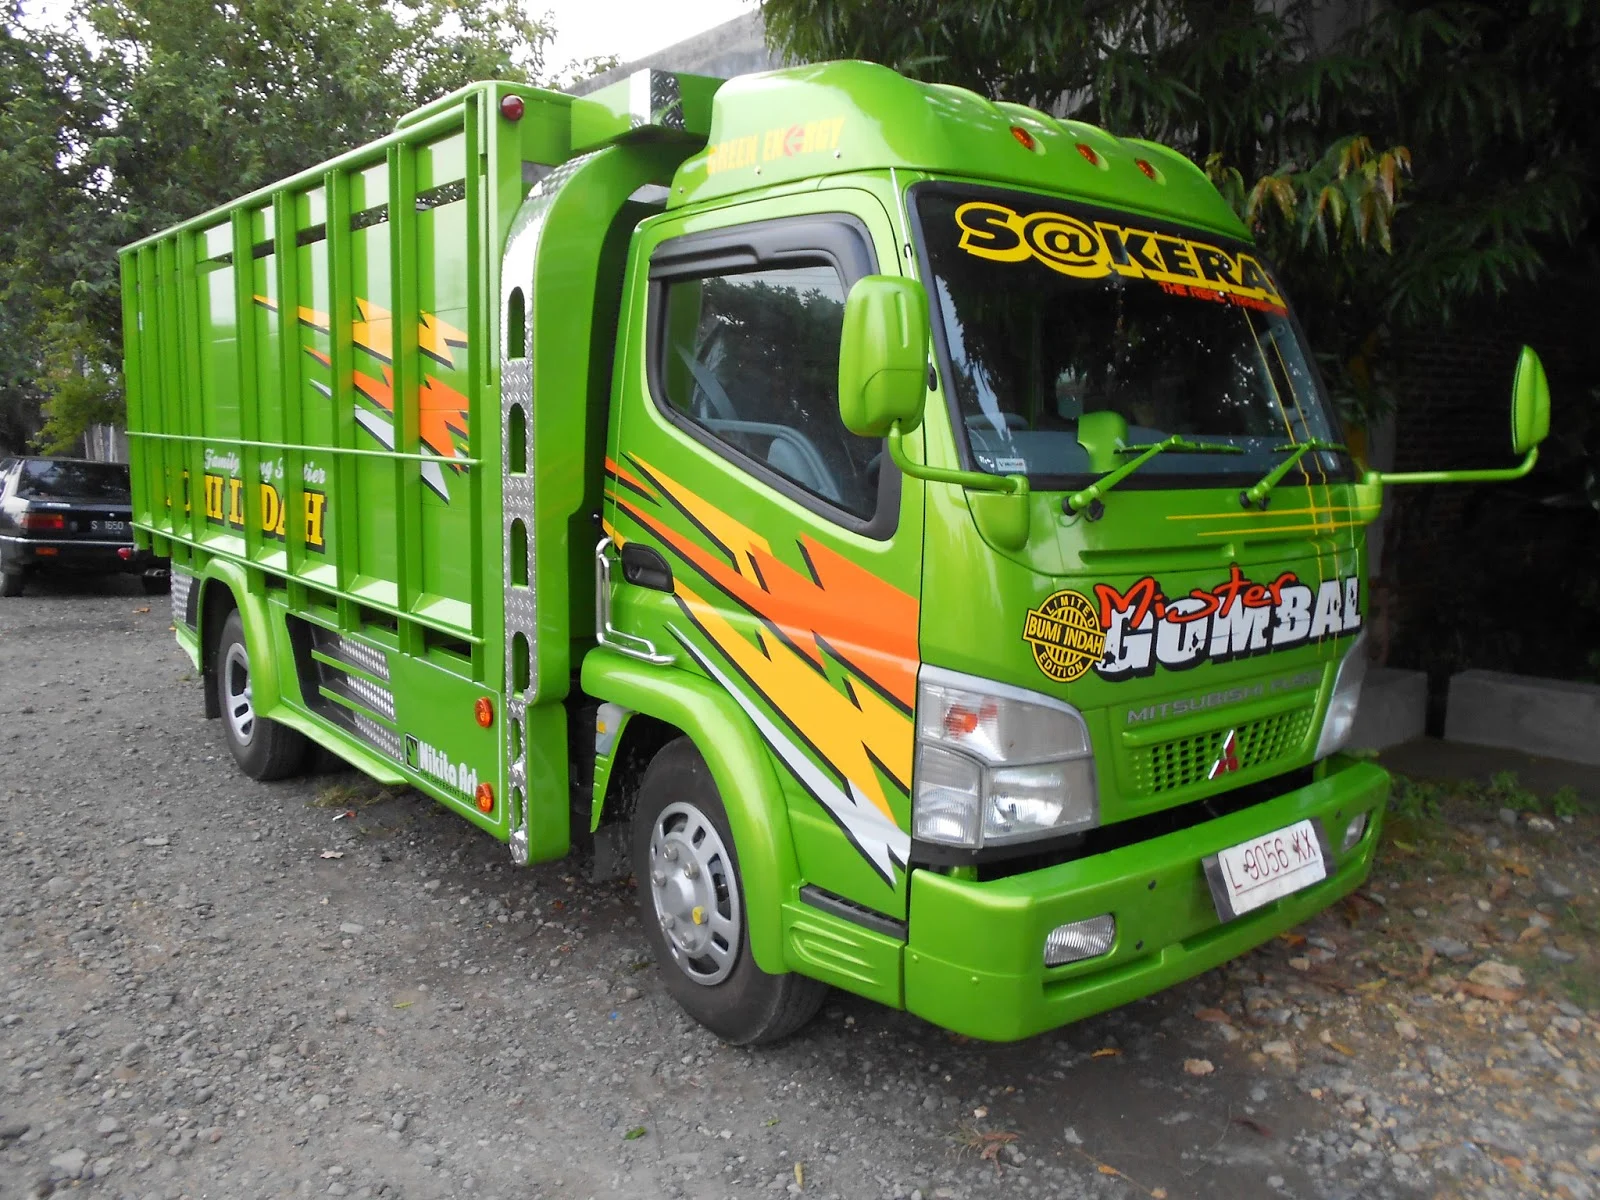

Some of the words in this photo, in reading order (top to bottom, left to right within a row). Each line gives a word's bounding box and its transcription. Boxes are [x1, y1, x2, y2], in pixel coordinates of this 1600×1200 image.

[955, 201, 1287, 310] S@KERA
[1046, 595, 1095, 628] LIMITED
[1094, 563, 1298, 628] Mister
[1063, 626, 1103, 654] INDAH
[1094, 576, 1361, 674] GOMBAL
[1127, 684, 1264, 724] MITSUBISHI
[1224, 857, 1242, 889] L
[1244, 837, 1289, 880] 9056
